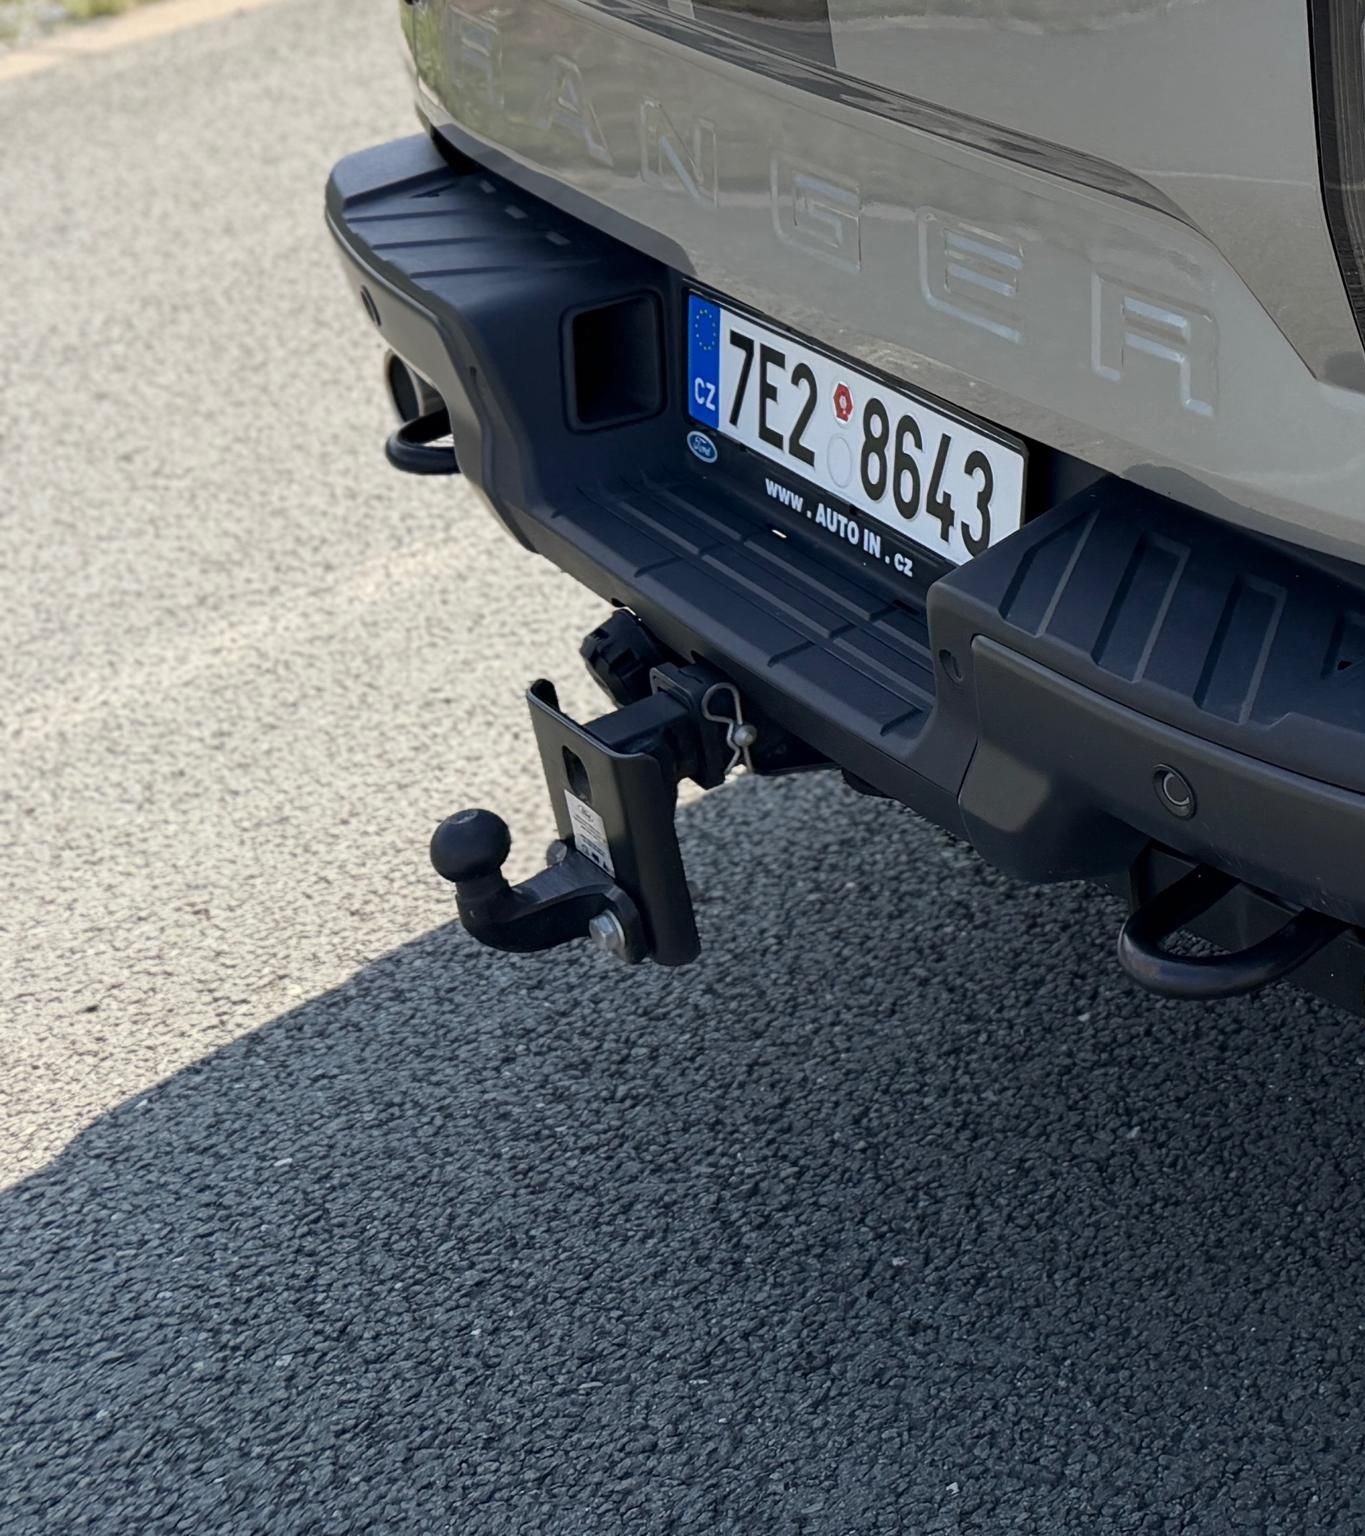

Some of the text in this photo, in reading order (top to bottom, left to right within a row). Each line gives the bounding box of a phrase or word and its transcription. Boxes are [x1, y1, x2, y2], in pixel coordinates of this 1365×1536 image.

[449, 5, 1220, 417] RANGER
[694, 376, 716, 412] CZ
[729, 329, 994, 559] 7E2 8643
